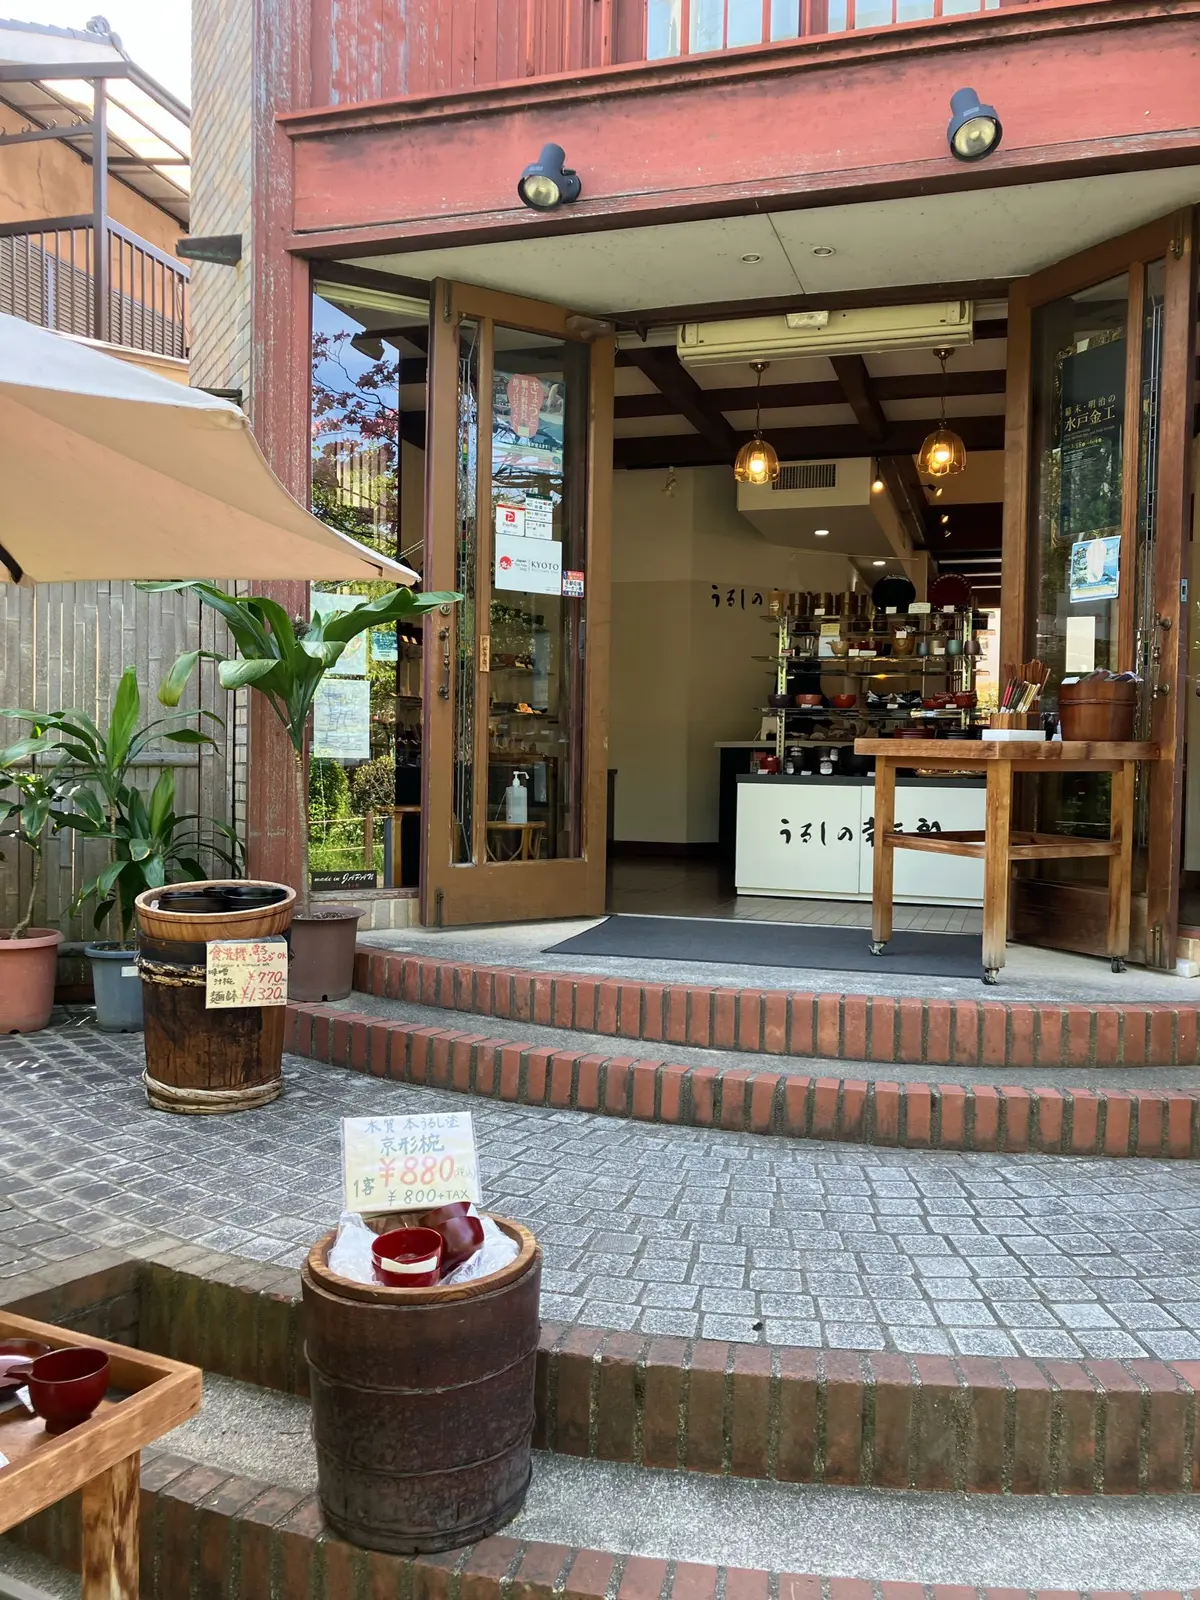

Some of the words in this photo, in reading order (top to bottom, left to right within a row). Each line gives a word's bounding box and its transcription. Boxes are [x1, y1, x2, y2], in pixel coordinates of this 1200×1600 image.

[1064, 405, 1116, 432] 水戸金工
[531, 560, 559, 571] KYOTO
[711, 584, 763, 609] うるしの
[341, 872, 374, 884] JAPAN
[379, 1155, 455, 1187] ¥880
[353, 1177, 375, 1198] 1客
